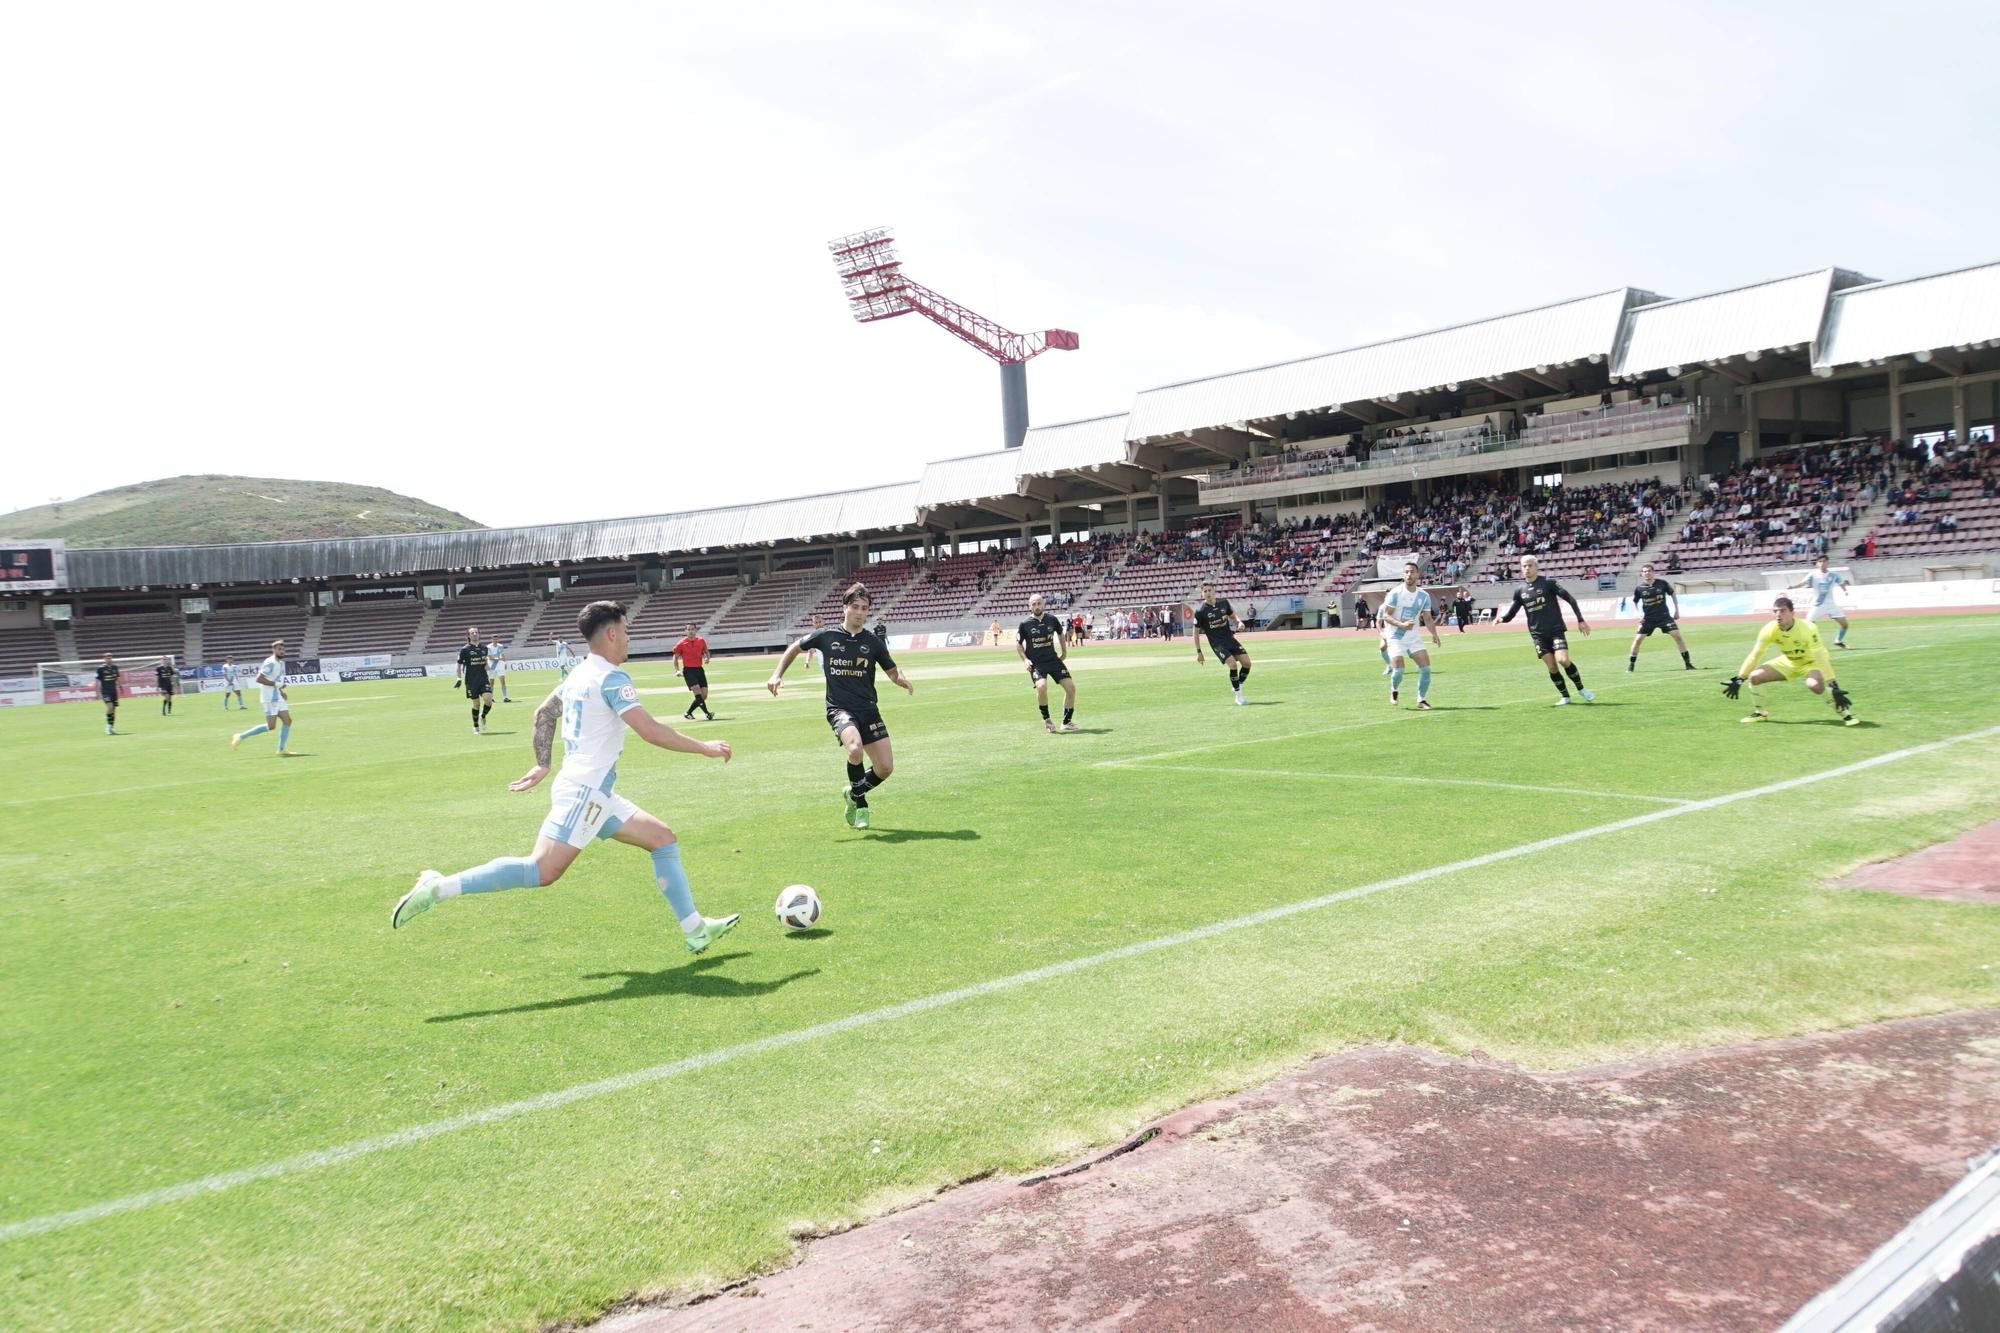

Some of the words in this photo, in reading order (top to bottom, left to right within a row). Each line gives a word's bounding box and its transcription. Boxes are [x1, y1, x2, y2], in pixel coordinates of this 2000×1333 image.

[829, 657, 853, 667] Feten
[830, 666, 863, 677] Domum
[584, 800, 602, 826] 17
